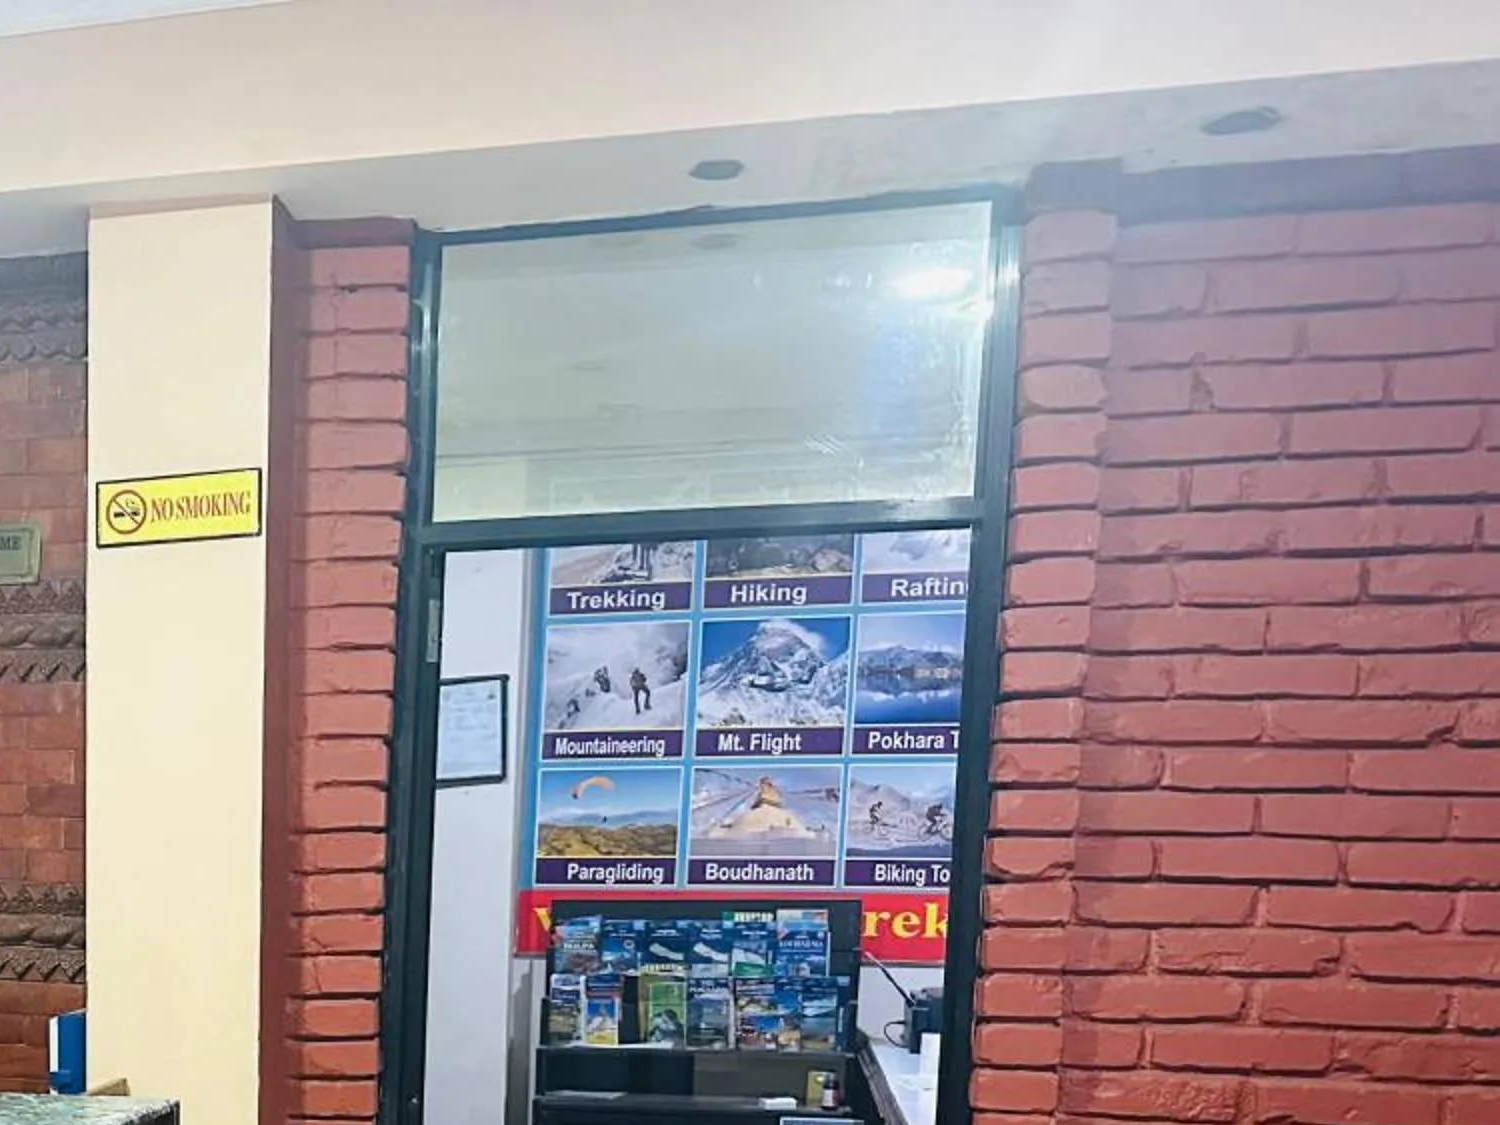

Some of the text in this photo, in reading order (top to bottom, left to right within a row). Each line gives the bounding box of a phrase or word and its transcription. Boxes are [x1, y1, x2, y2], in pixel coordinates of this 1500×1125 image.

[151, 490, 251, 522] NO SMOKING
[731, 583, 808, 605] Hiking
[891, 577, 968, 597] Raftin
[567, 589, 666, 611] Trekking
[555, 736, 666, 758] Mountaineering
[718, 732, 802, 756] Mt. Flight
[868, 731, 945, 749] Pokhara
[567, 862, 665, 885] Paragliding
[705, 862, 814, 882] Boudhanath
[874, 863, 951, 887] Biking To
